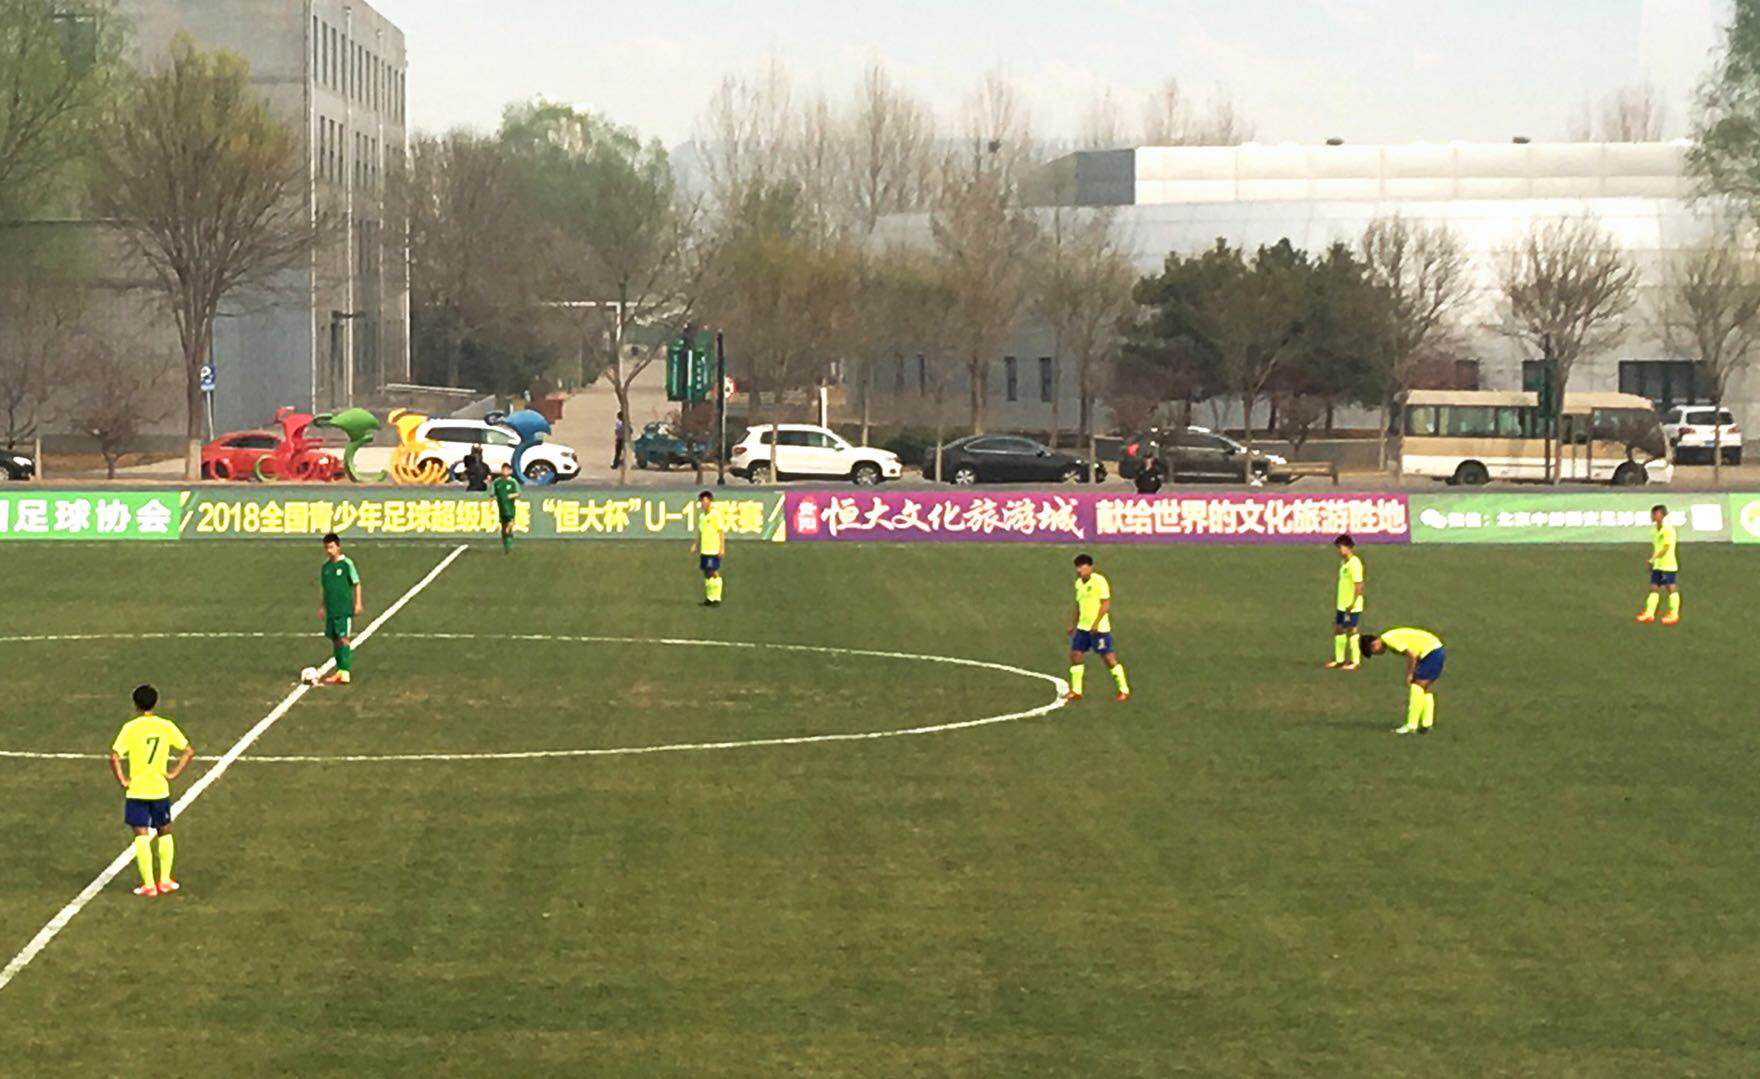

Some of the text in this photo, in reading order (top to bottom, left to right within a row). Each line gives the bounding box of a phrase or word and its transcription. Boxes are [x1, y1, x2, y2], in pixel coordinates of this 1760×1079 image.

[0, 499, 171, 533] 足球协会
[820, 496, 1084, 539] 恒大文化旅游城
[1095, 498, 1408, 534] 献给世界的文化旅游胜地
[146, 736, 160, 765] 7
